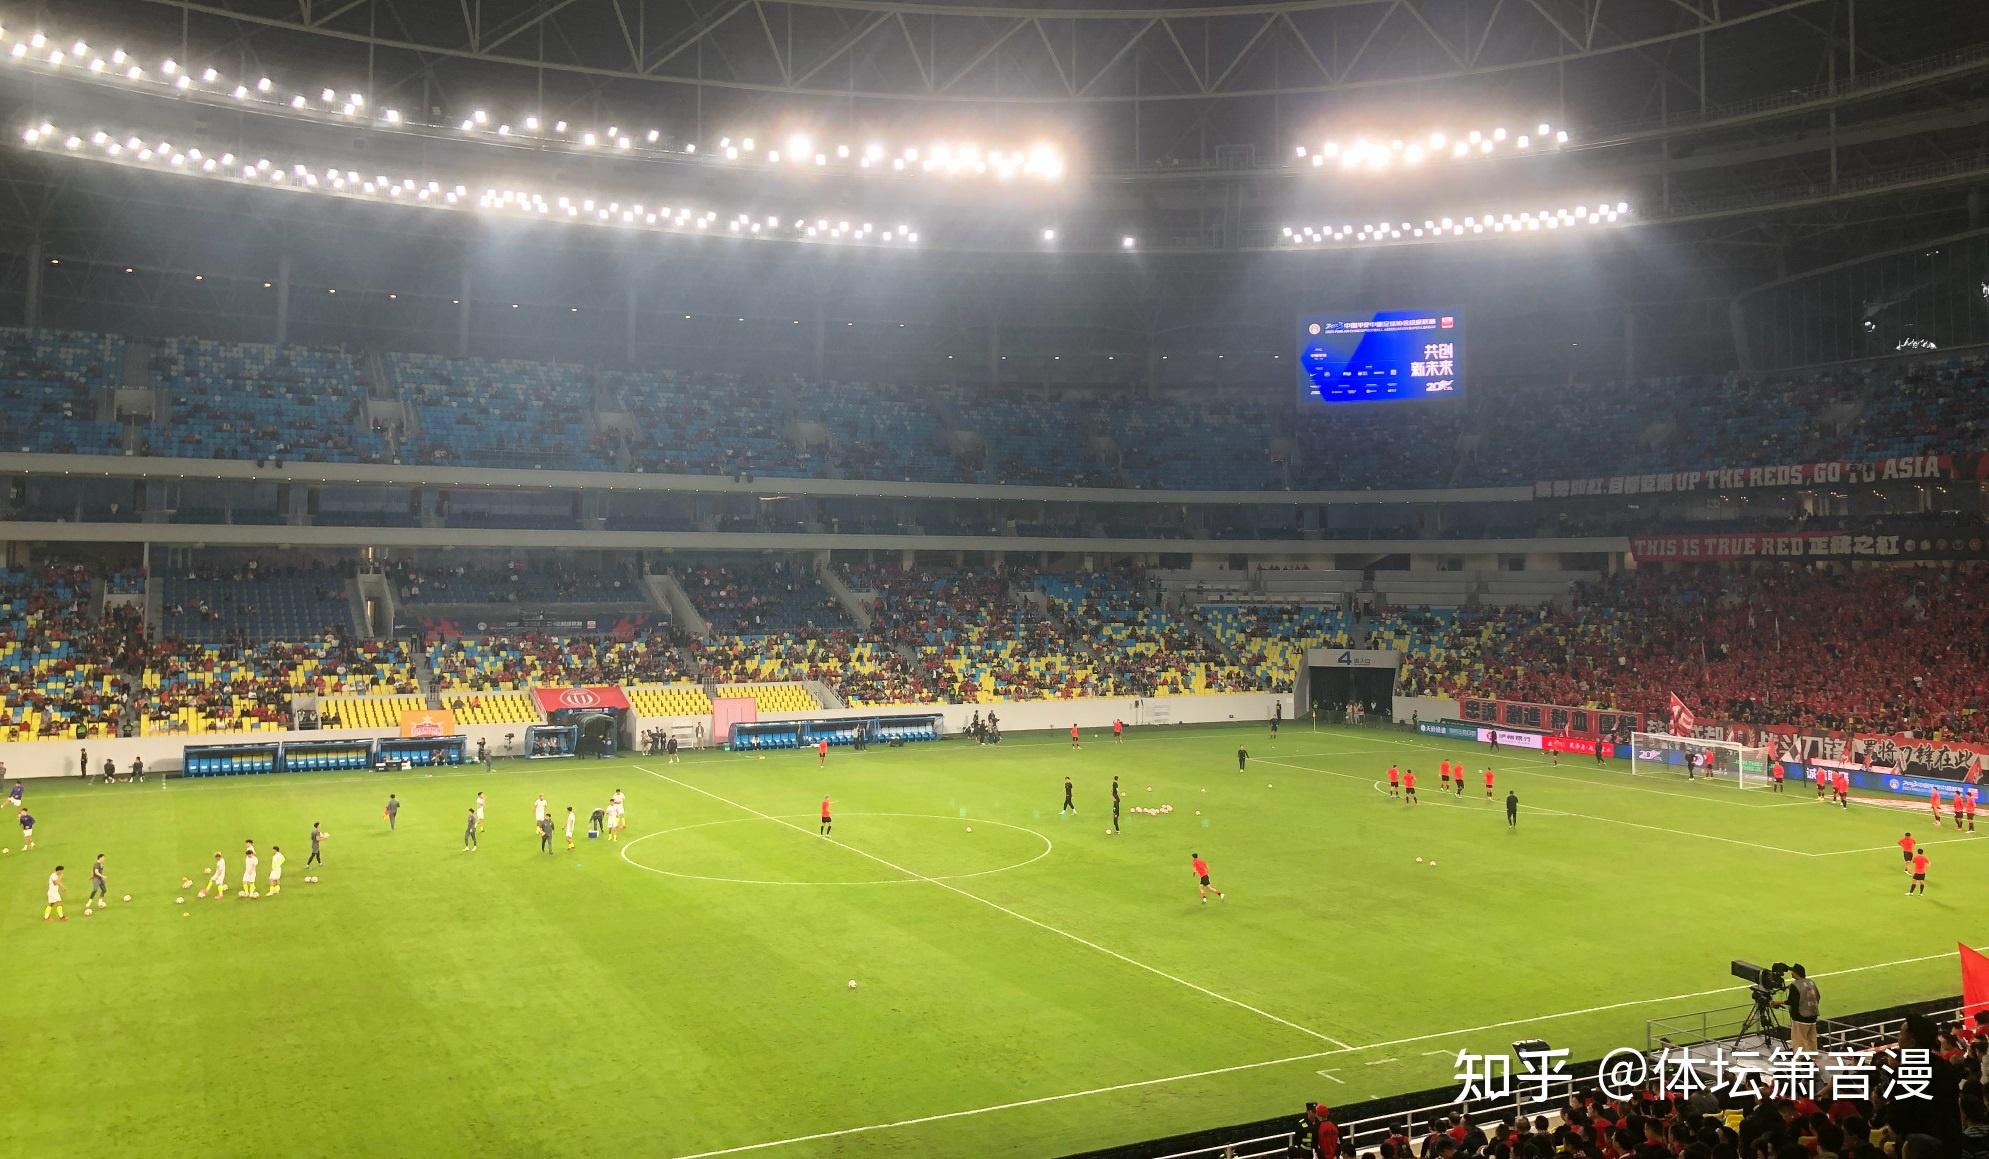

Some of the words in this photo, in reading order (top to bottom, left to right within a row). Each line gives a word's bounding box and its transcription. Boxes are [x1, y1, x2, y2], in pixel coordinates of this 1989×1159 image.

[1424, 343, 1454, 360] 共创
[1410, 360, 1454, 377] 新未来
[1676, 471, 1701, 492] UP
[1706, 468, 1744, 490] THE
[1813, 462, 1841, 484] GO
[1882, 455, 1941, 481] ASIA
[1635, 538, 1677, 556] THIS
[1682, 538, 1700, 556] IS
[1704, 537, 1756, 556] TRUE
[1761, 537, 1804, 555] RED
[1338, 651, 1352, 665] 4
